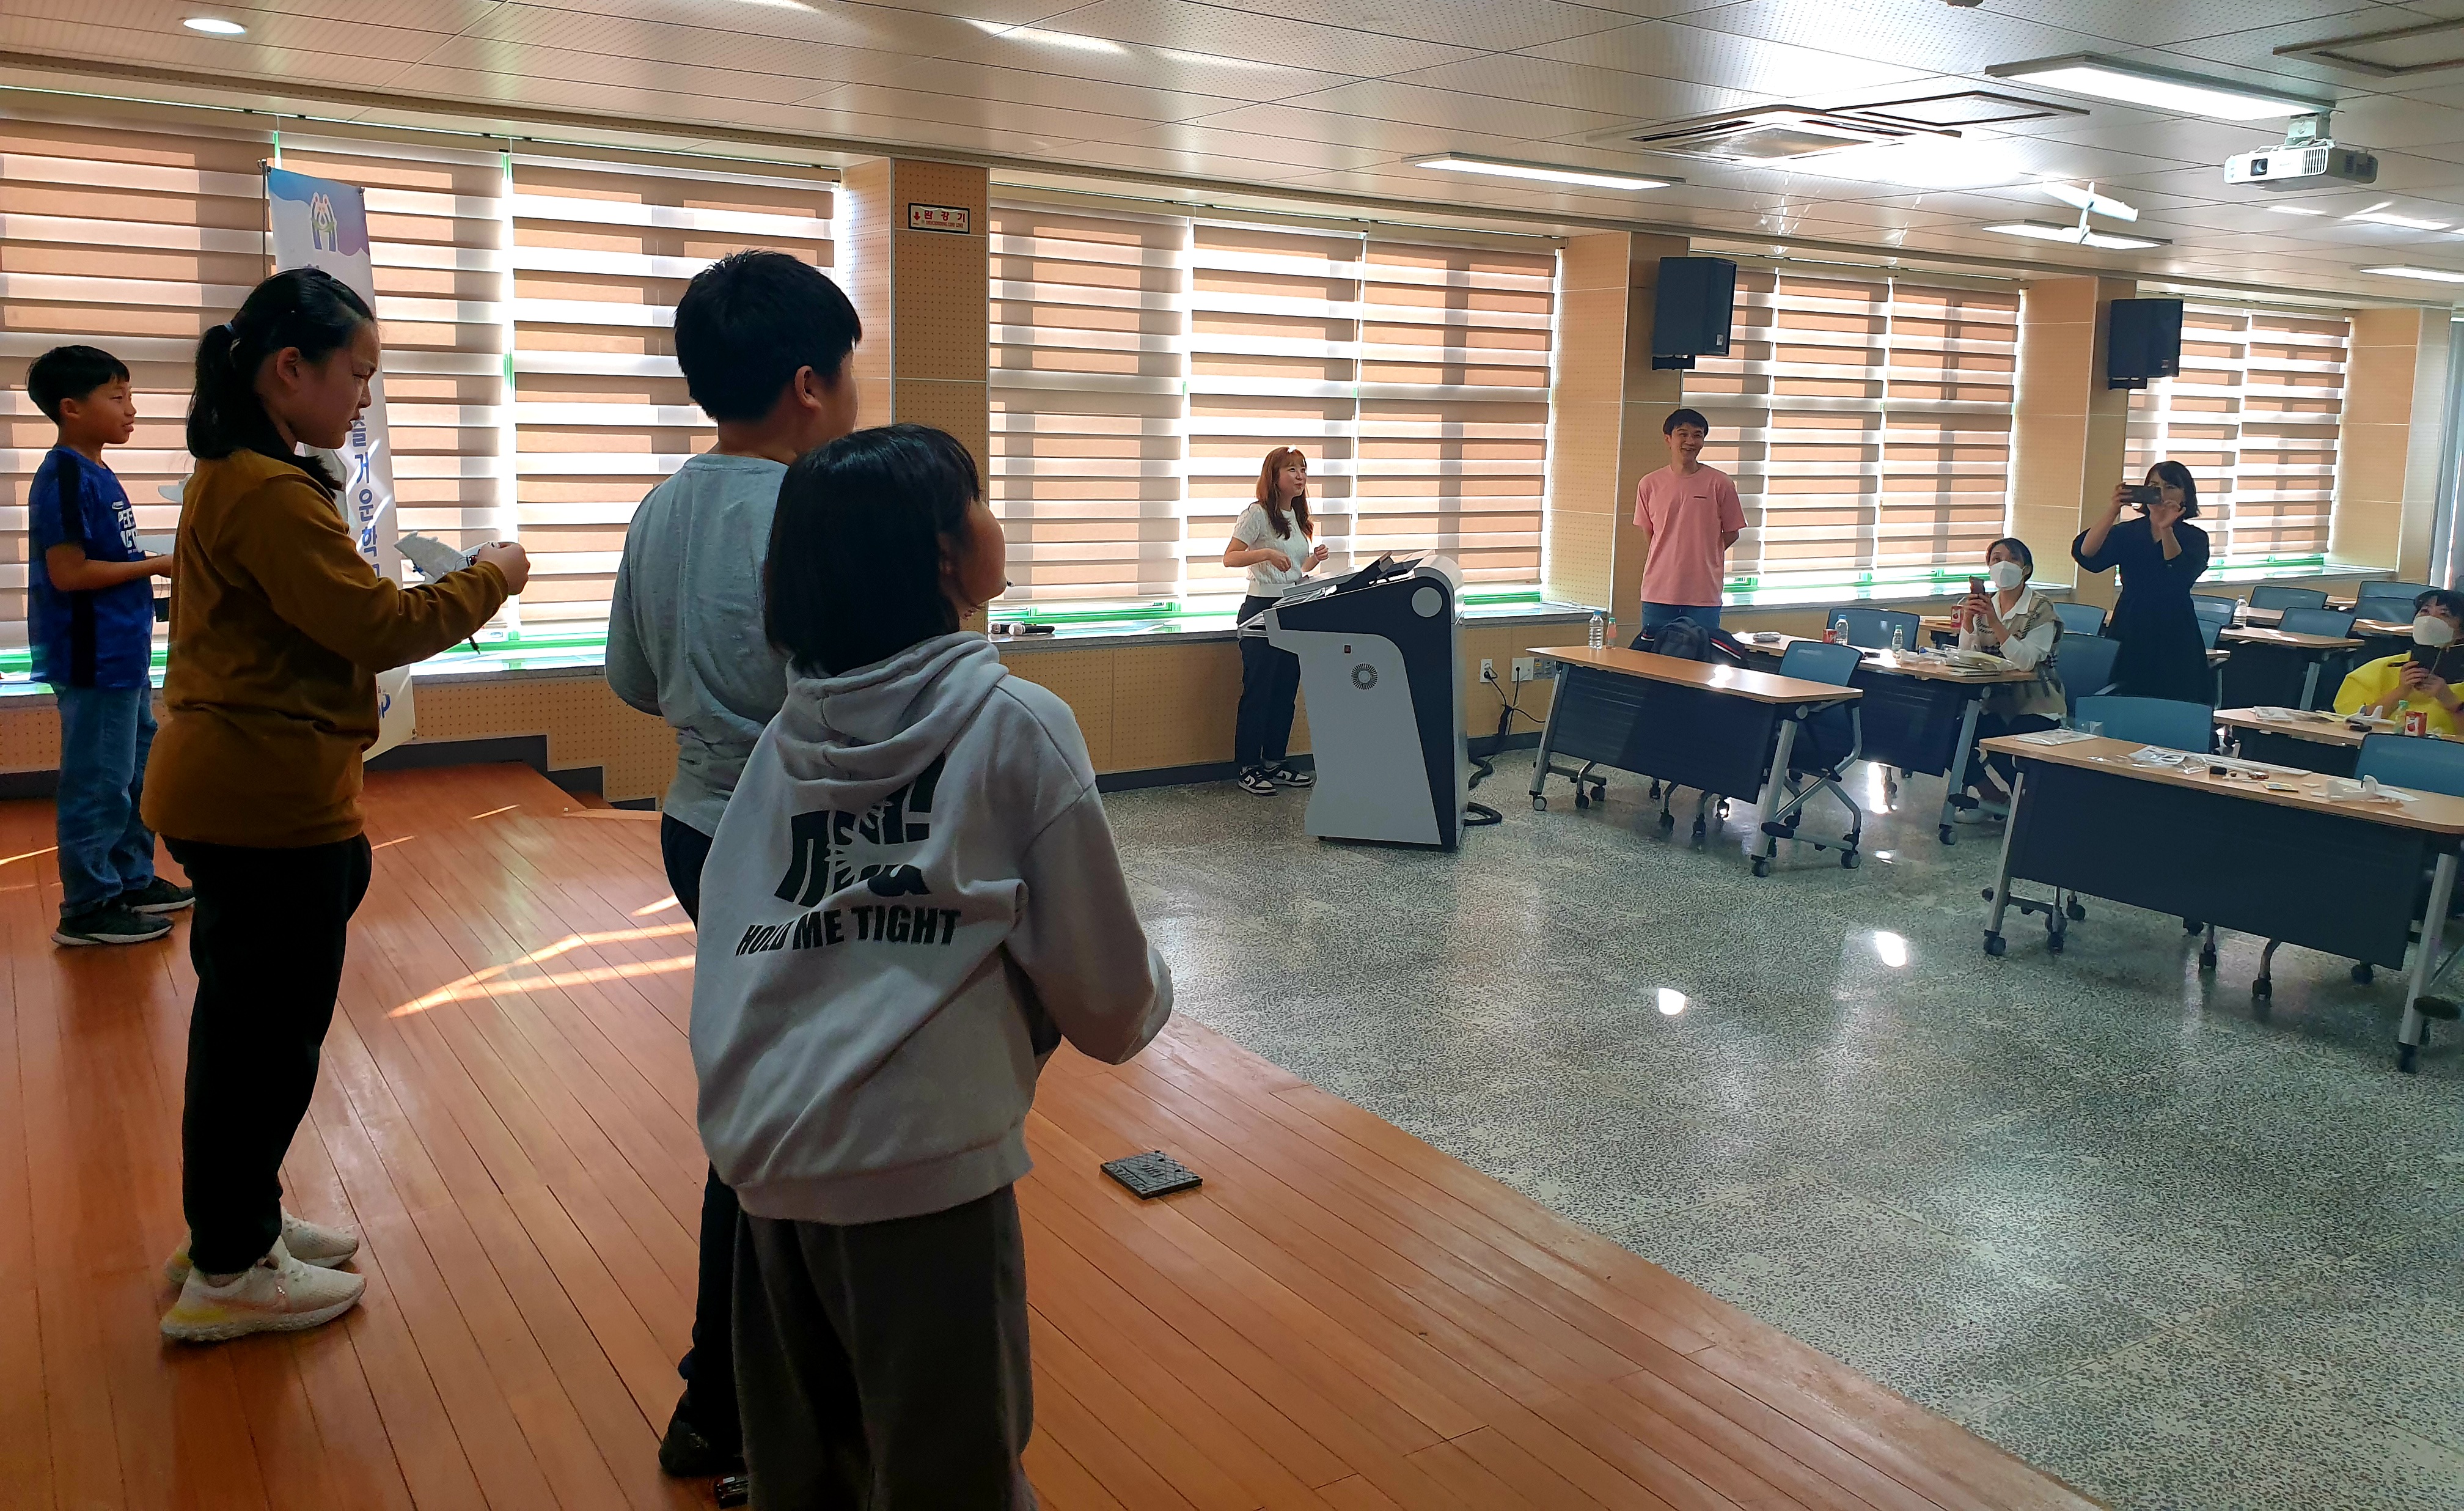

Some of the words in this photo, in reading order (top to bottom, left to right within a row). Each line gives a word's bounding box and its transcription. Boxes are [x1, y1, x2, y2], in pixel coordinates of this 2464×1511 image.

[735, 919, 796, 955] HOLD
[793, 910, 844, 950] ME
[851, 905, 961, 946] TIGHT
